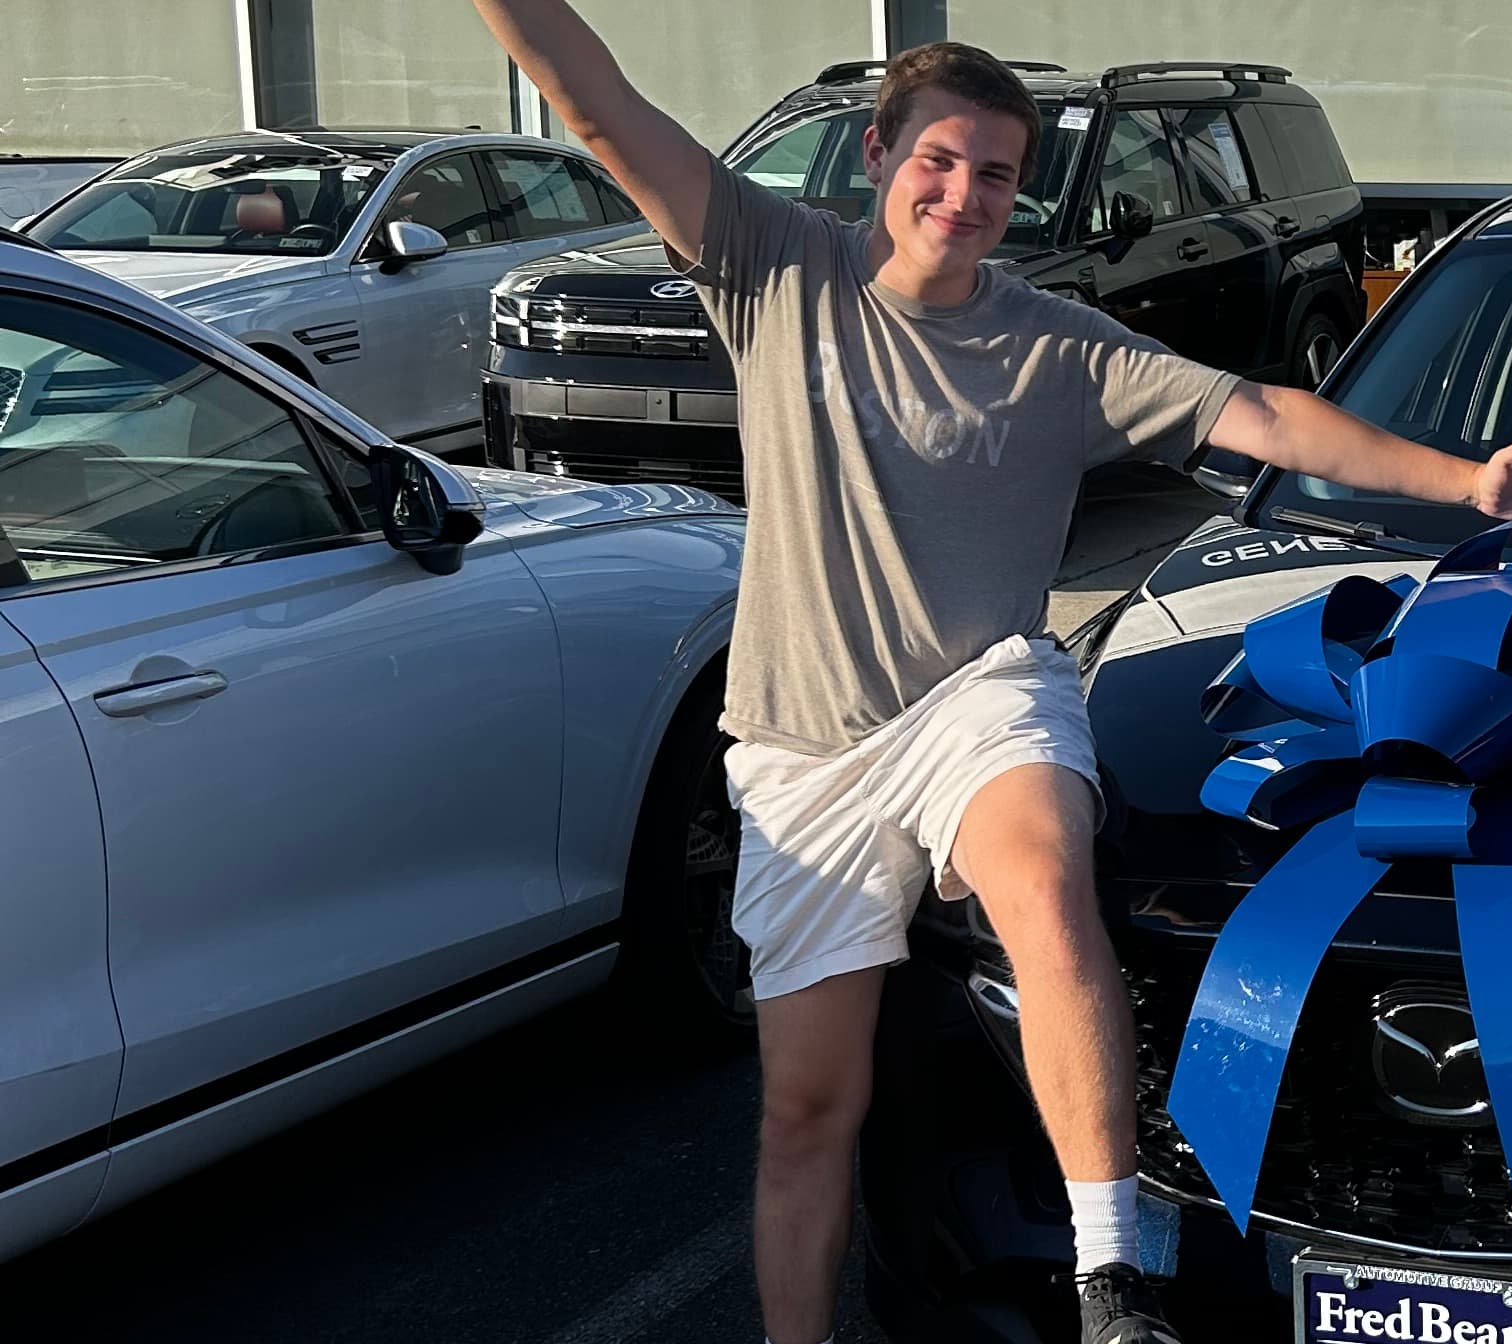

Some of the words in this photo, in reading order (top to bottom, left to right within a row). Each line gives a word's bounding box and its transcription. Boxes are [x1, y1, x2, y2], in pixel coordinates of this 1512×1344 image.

[1354, 1264, 1448, 1289] AUTOMOTIVE
[1448, 1275, 1504, 1294] GROUP
[1315, 1291, 1414, 1340] Fred
